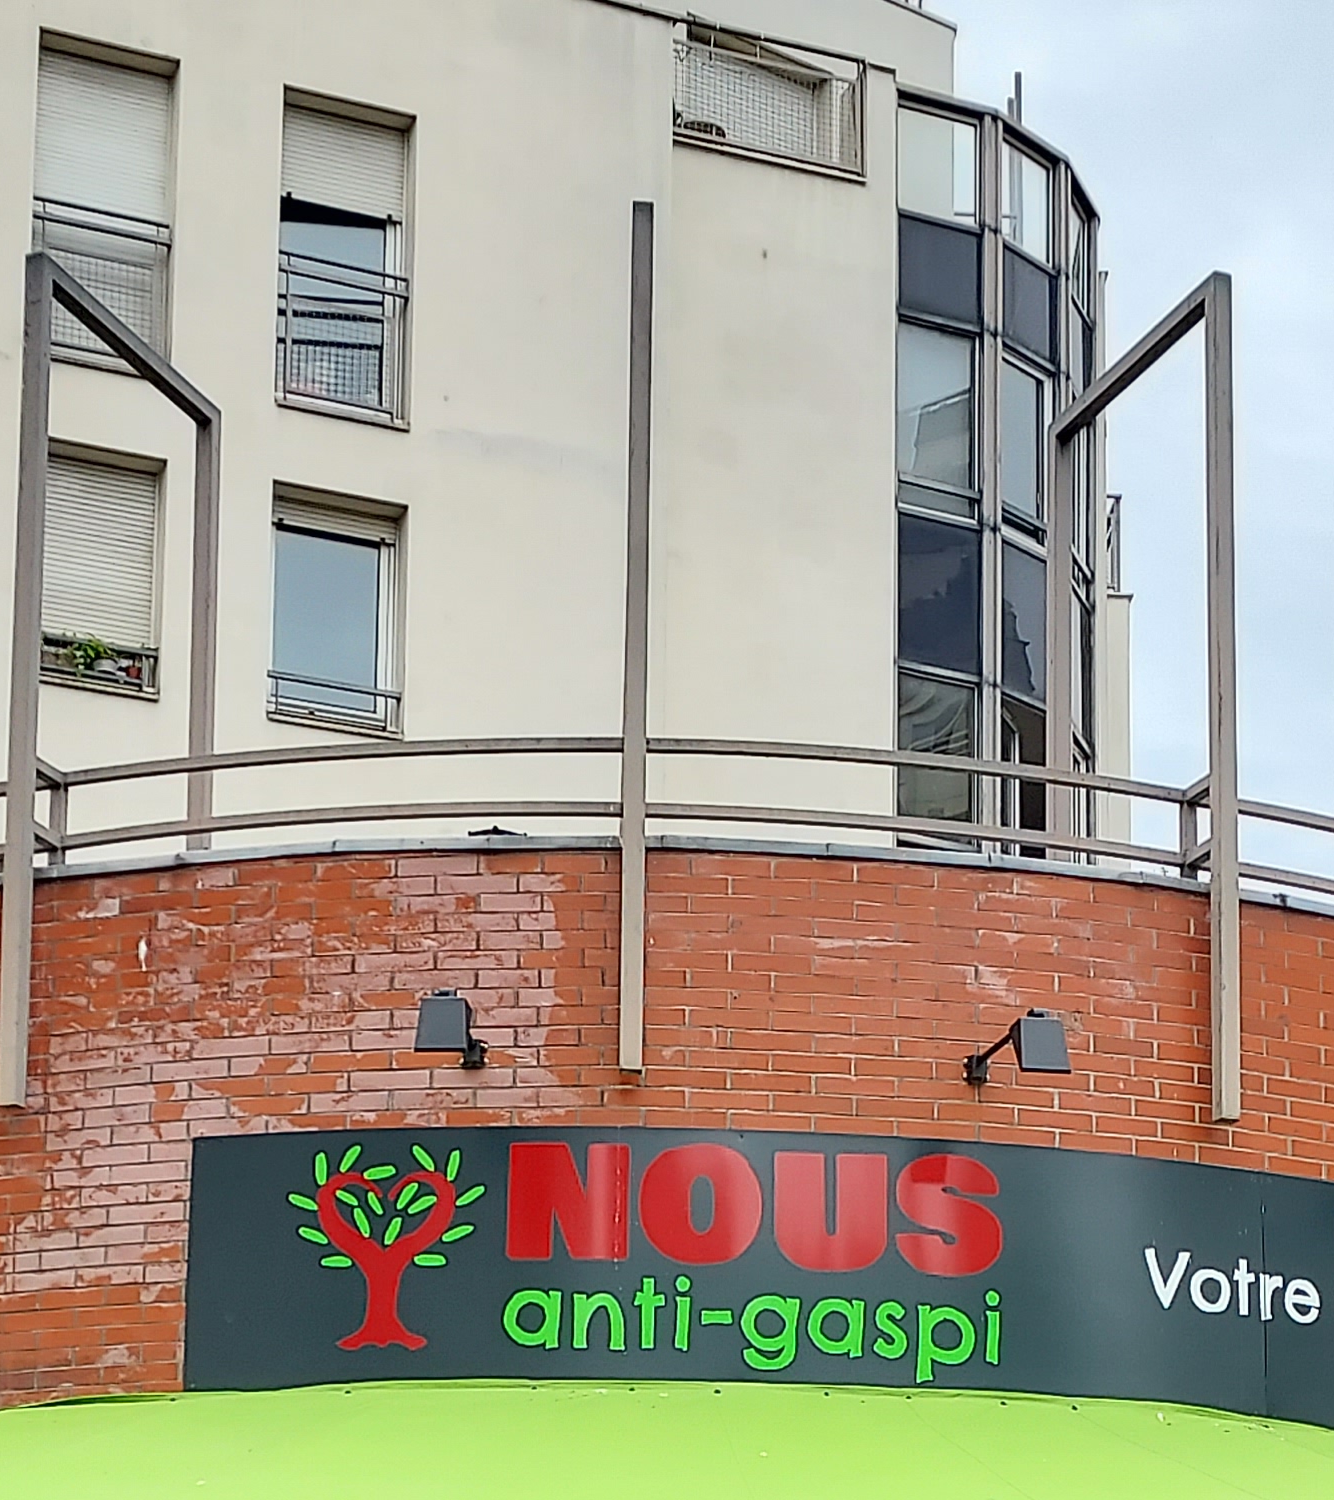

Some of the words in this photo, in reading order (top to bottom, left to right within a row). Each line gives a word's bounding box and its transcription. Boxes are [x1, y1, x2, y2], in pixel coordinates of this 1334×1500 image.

[506, 1142, 1002, 1276] NOUS
[502, 1274, 1002, 1383] anti-gaspi
[1145, 1247, 1320, 1324] Votre
